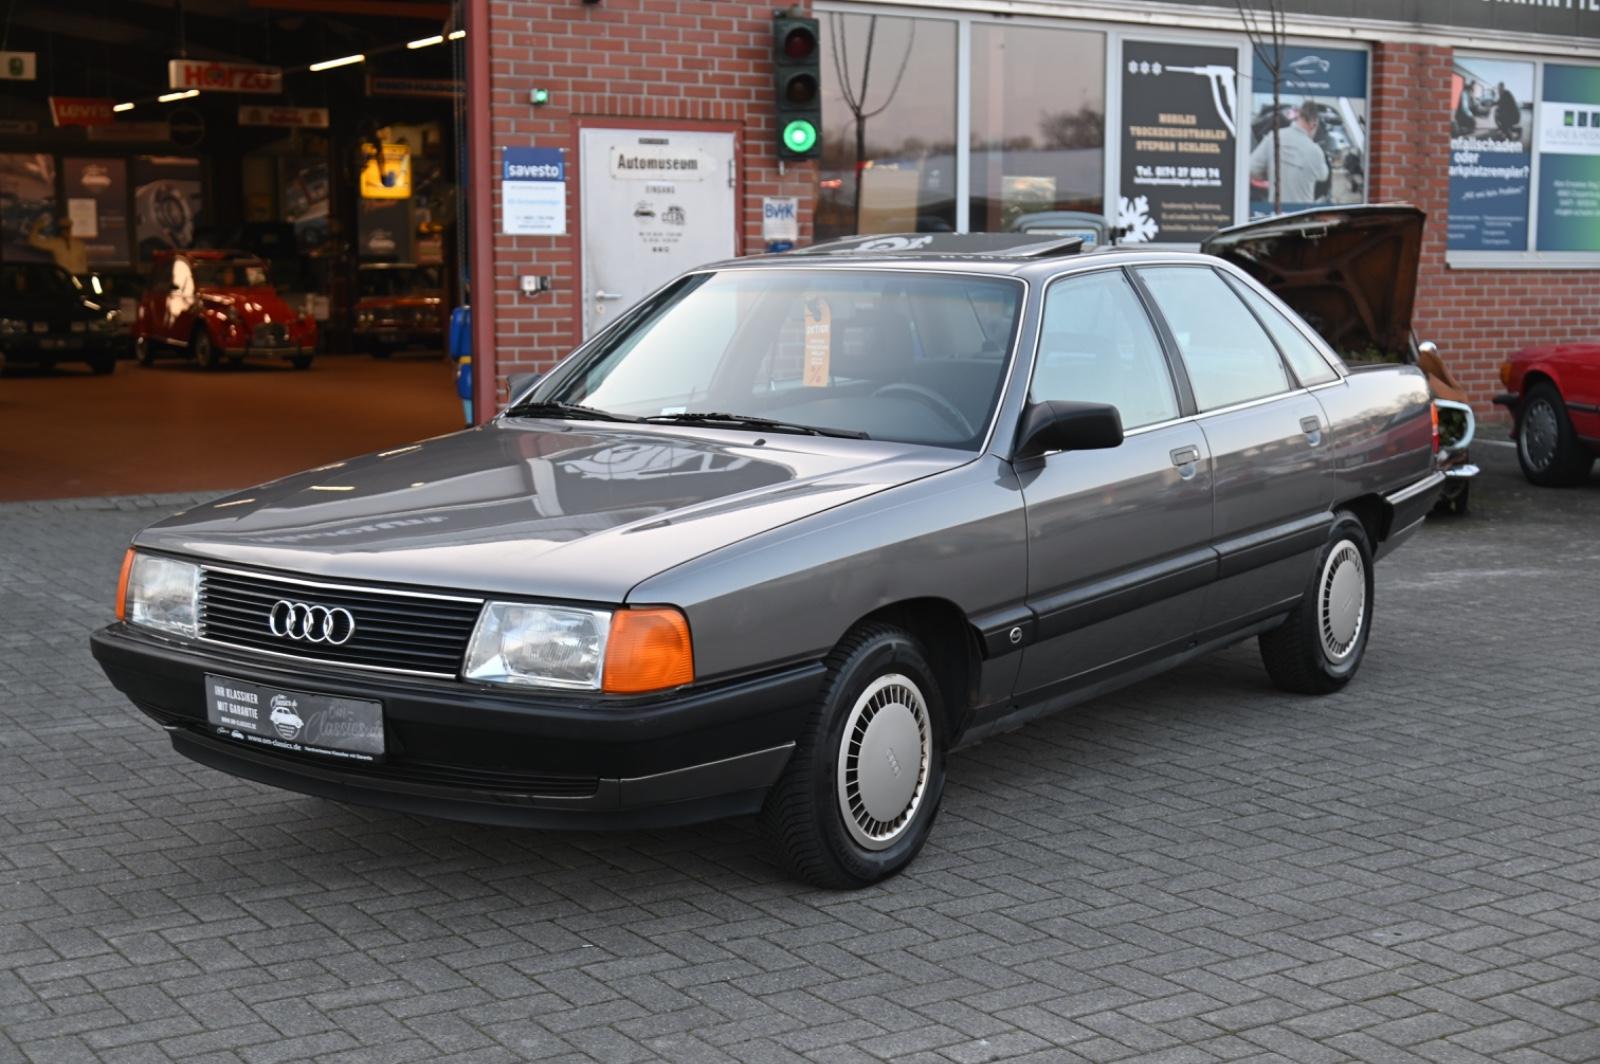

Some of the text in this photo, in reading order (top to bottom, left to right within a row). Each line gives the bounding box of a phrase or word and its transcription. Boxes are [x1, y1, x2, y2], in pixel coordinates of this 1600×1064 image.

[1450, 136, 1523, 153] nfallschaden
[617, 154, 698, 170] Automuseum
[1454, 151, 1479, 164] oder
[1136, 165, 1153, 177] Tel.
[1449, 164, 1529, 180] arkplatzrempler?
[214, 685, 259, 704] IHR KLASSIKER
[217, 700, 258, 720] MIT GARANTIE
